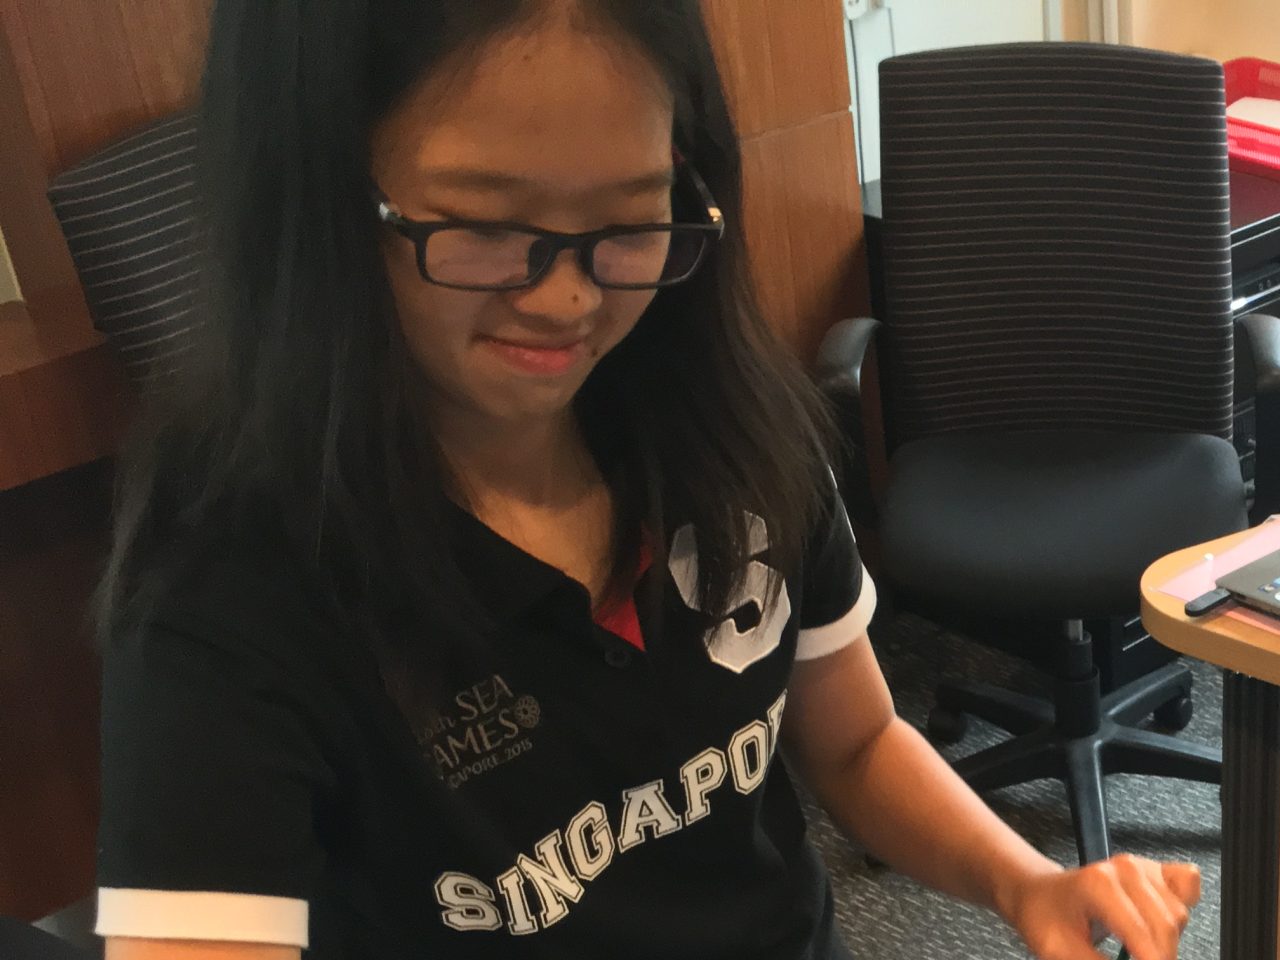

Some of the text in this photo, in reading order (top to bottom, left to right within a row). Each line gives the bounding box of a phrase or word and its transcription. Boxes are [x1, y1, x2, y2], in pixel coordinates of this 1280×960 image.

[455, 673, 515, 721] SEA
[426, 707, 520, 769] AMES
[504, 737, 534, 762] 2015
